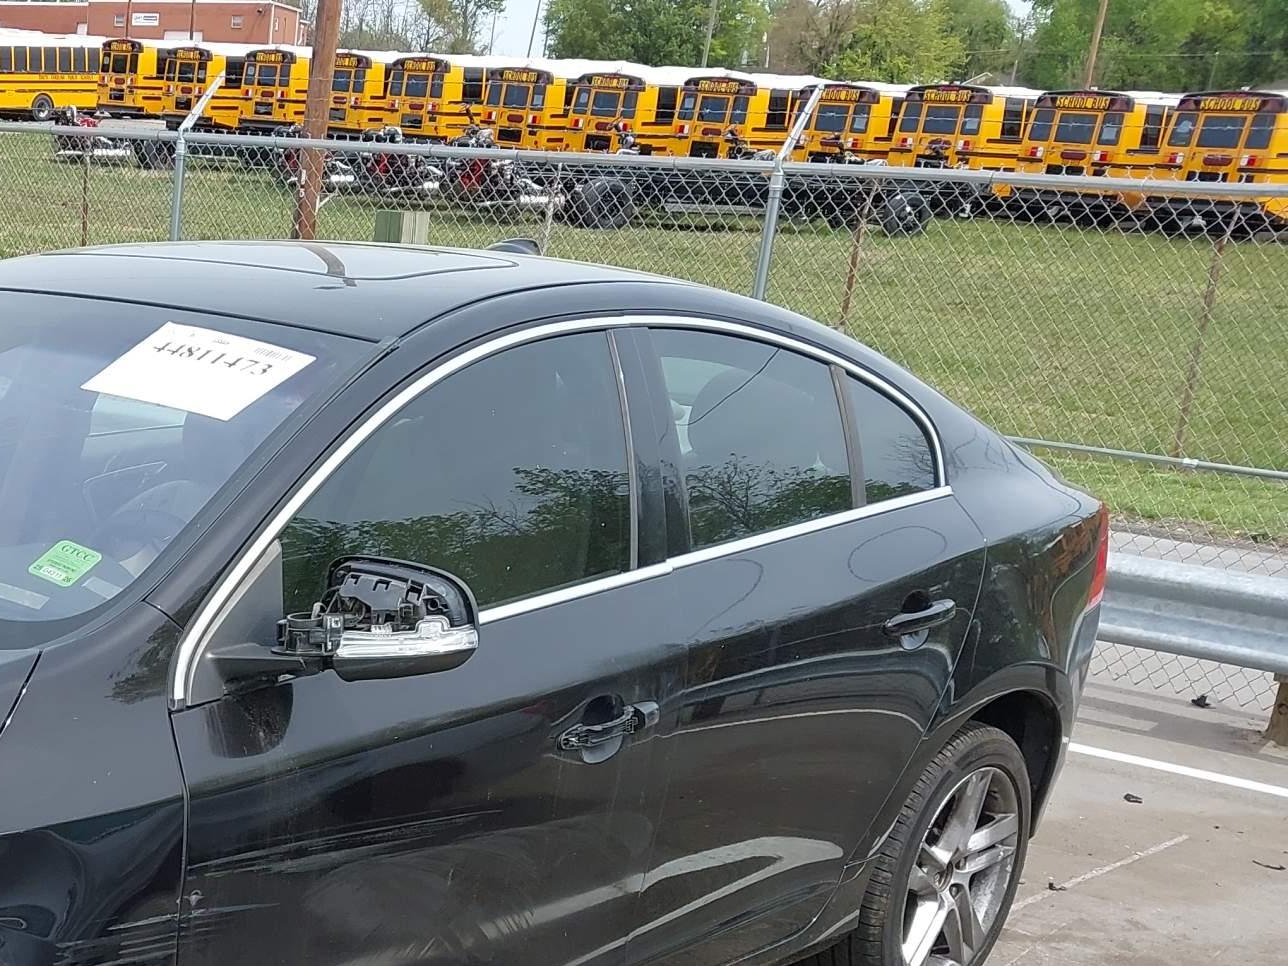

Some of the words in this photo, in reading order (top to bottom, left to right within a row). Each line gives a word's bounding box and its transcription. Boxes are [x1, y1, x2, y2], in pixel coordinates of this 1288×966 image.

[845, 89, 859, 101] BUS
[924, 90, 953, 101] SCHOOL
[957, 90, 971, 102] BUS
[1057, 96, 1088, 108] SCHOOL
[1092, 97, 1110, 109] BUS
[1200, 97, 1237, 110] SCHOOL
[1239, 98, 1260, 111] BUS
[153, 342, 273, 376] 44811473
[61, 544, 94, 561] GTCC
